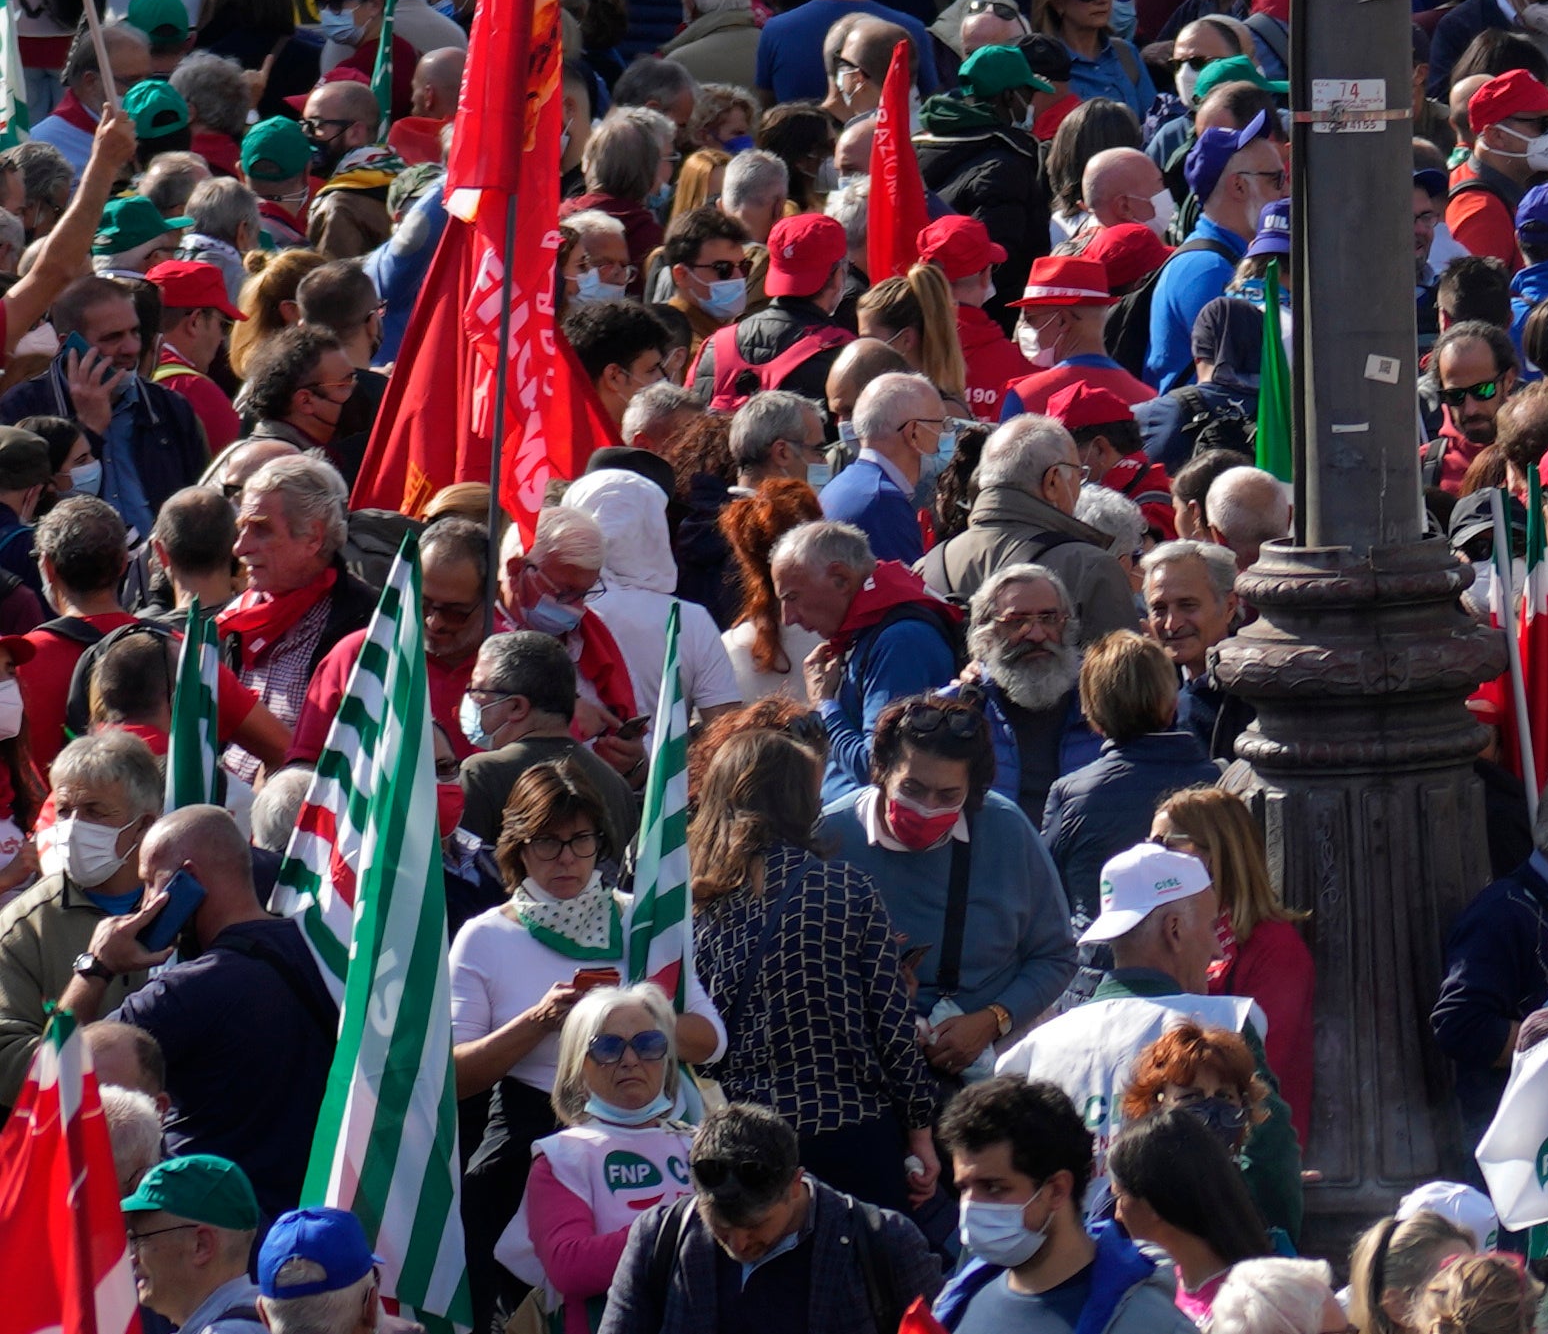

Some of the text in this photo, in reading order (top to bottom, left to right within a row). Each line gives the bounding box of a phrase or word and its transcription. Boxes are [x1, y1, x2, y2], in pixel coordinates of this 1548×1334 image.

[964, 386, 999, 407] 190
[1154, 877, 1181, 894] CISL
[608, 1158, 655, 1190] FNP
